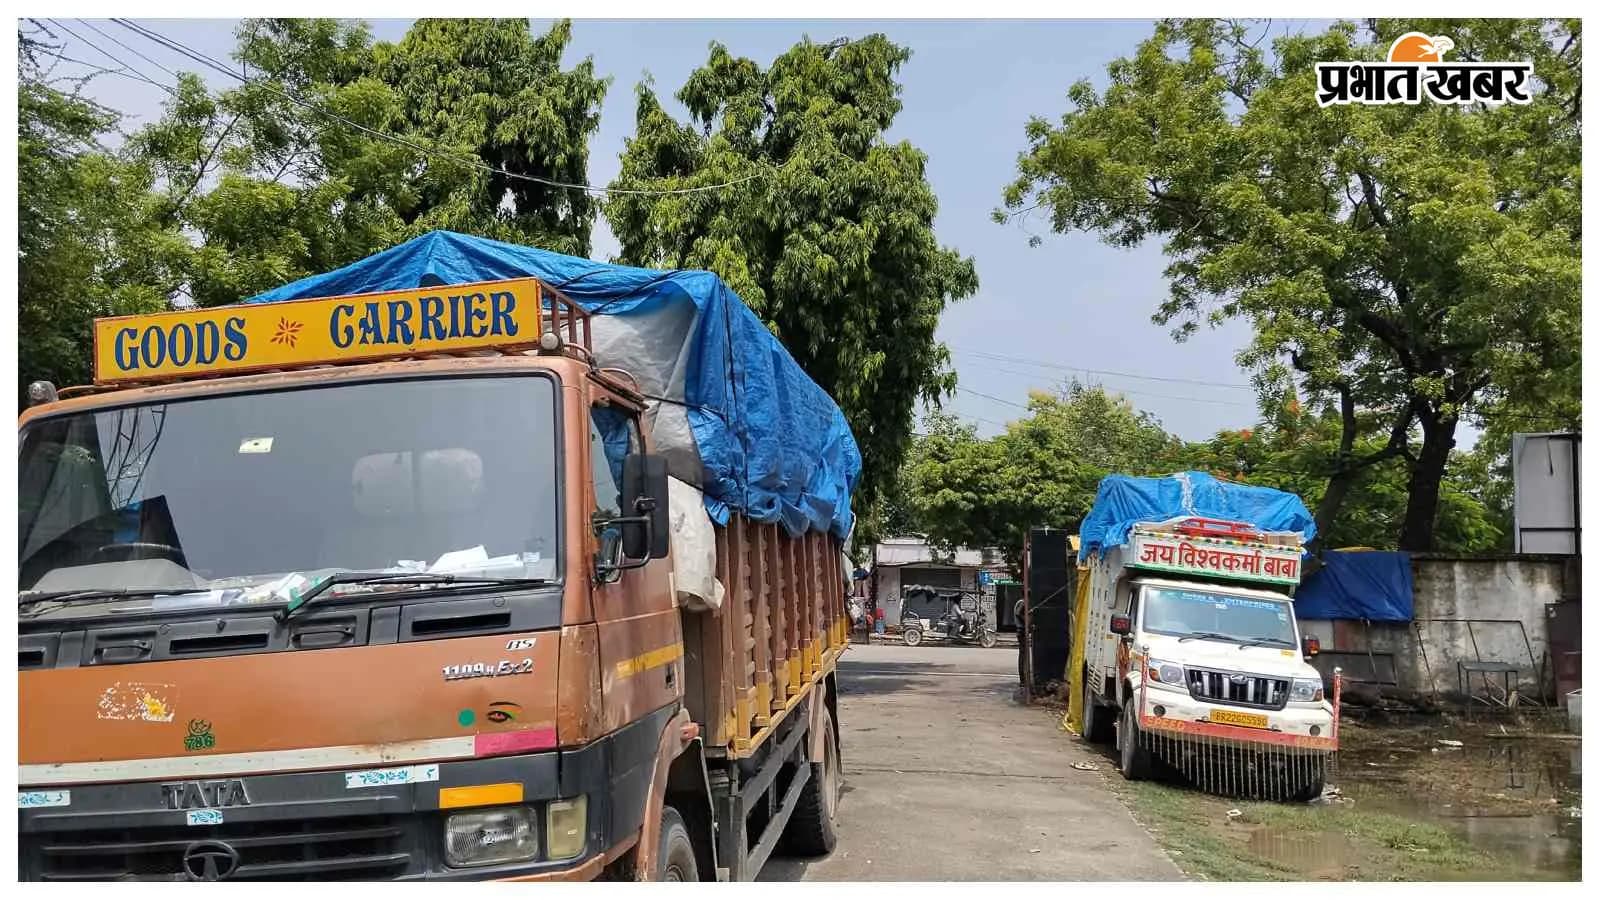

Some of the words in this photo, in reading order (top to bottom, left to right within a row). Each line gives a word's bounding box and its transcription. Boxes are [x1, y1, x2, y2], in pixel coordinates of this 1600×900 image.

[115, 317, 248, 371] GOODS
[329, 291, 519, 348] CARRIER
[1140, 543, 1175, 564] जय
[1178, 542, 1262, 574] विश्वकर्मा
[1263, 556, 1298, 578] बाबा
[160, 777, 251, 809] TATA
